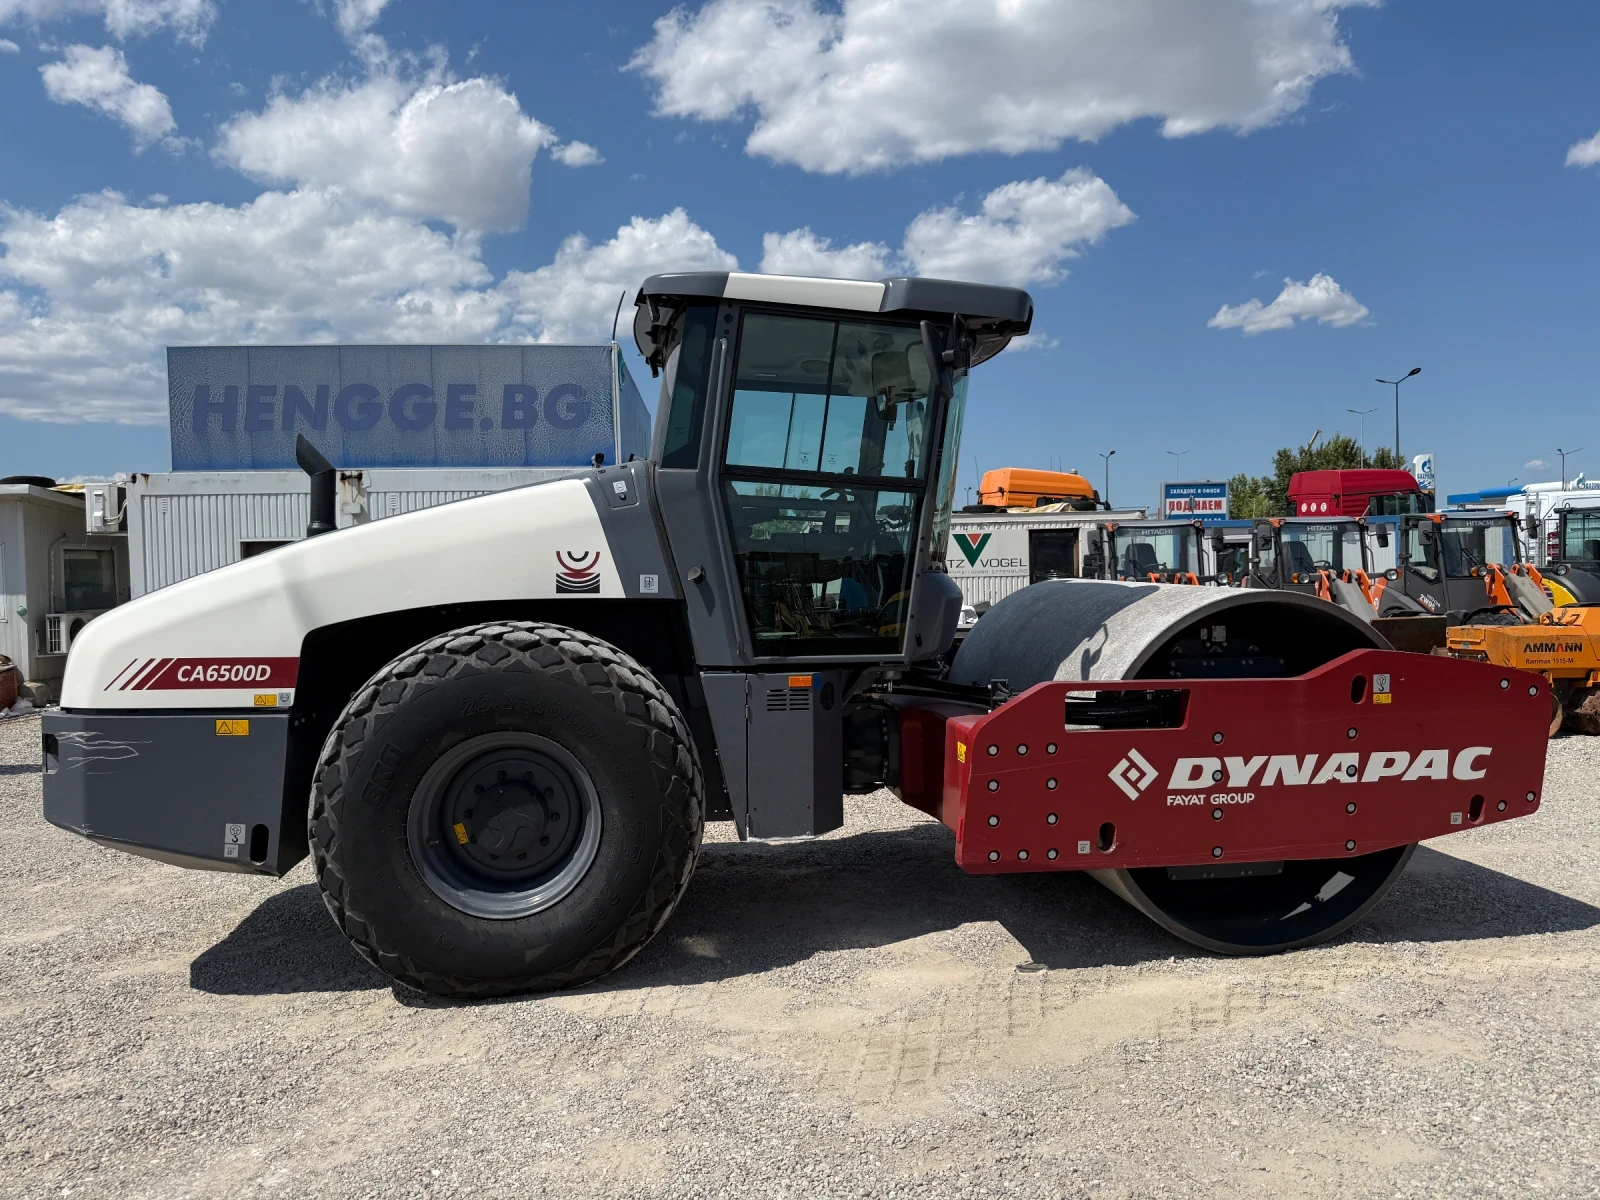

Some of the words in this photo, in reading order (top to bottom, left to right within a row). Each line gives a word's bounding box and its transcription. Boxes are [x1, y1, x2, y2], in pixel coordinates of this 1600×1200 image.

[191, 383, 591, 432] HENGGE.BG
[980, 558, 1027, 568] VOGEL
[1523, 642, 1583, 653] AMMANN
[177, 664, 271, 682] CA6500D
[1167, 746, 1492, 790] DYNAPAC
[1166, 794, 1206, 806] FAYAT
[1210, 792, 1255, 805] GROUP
